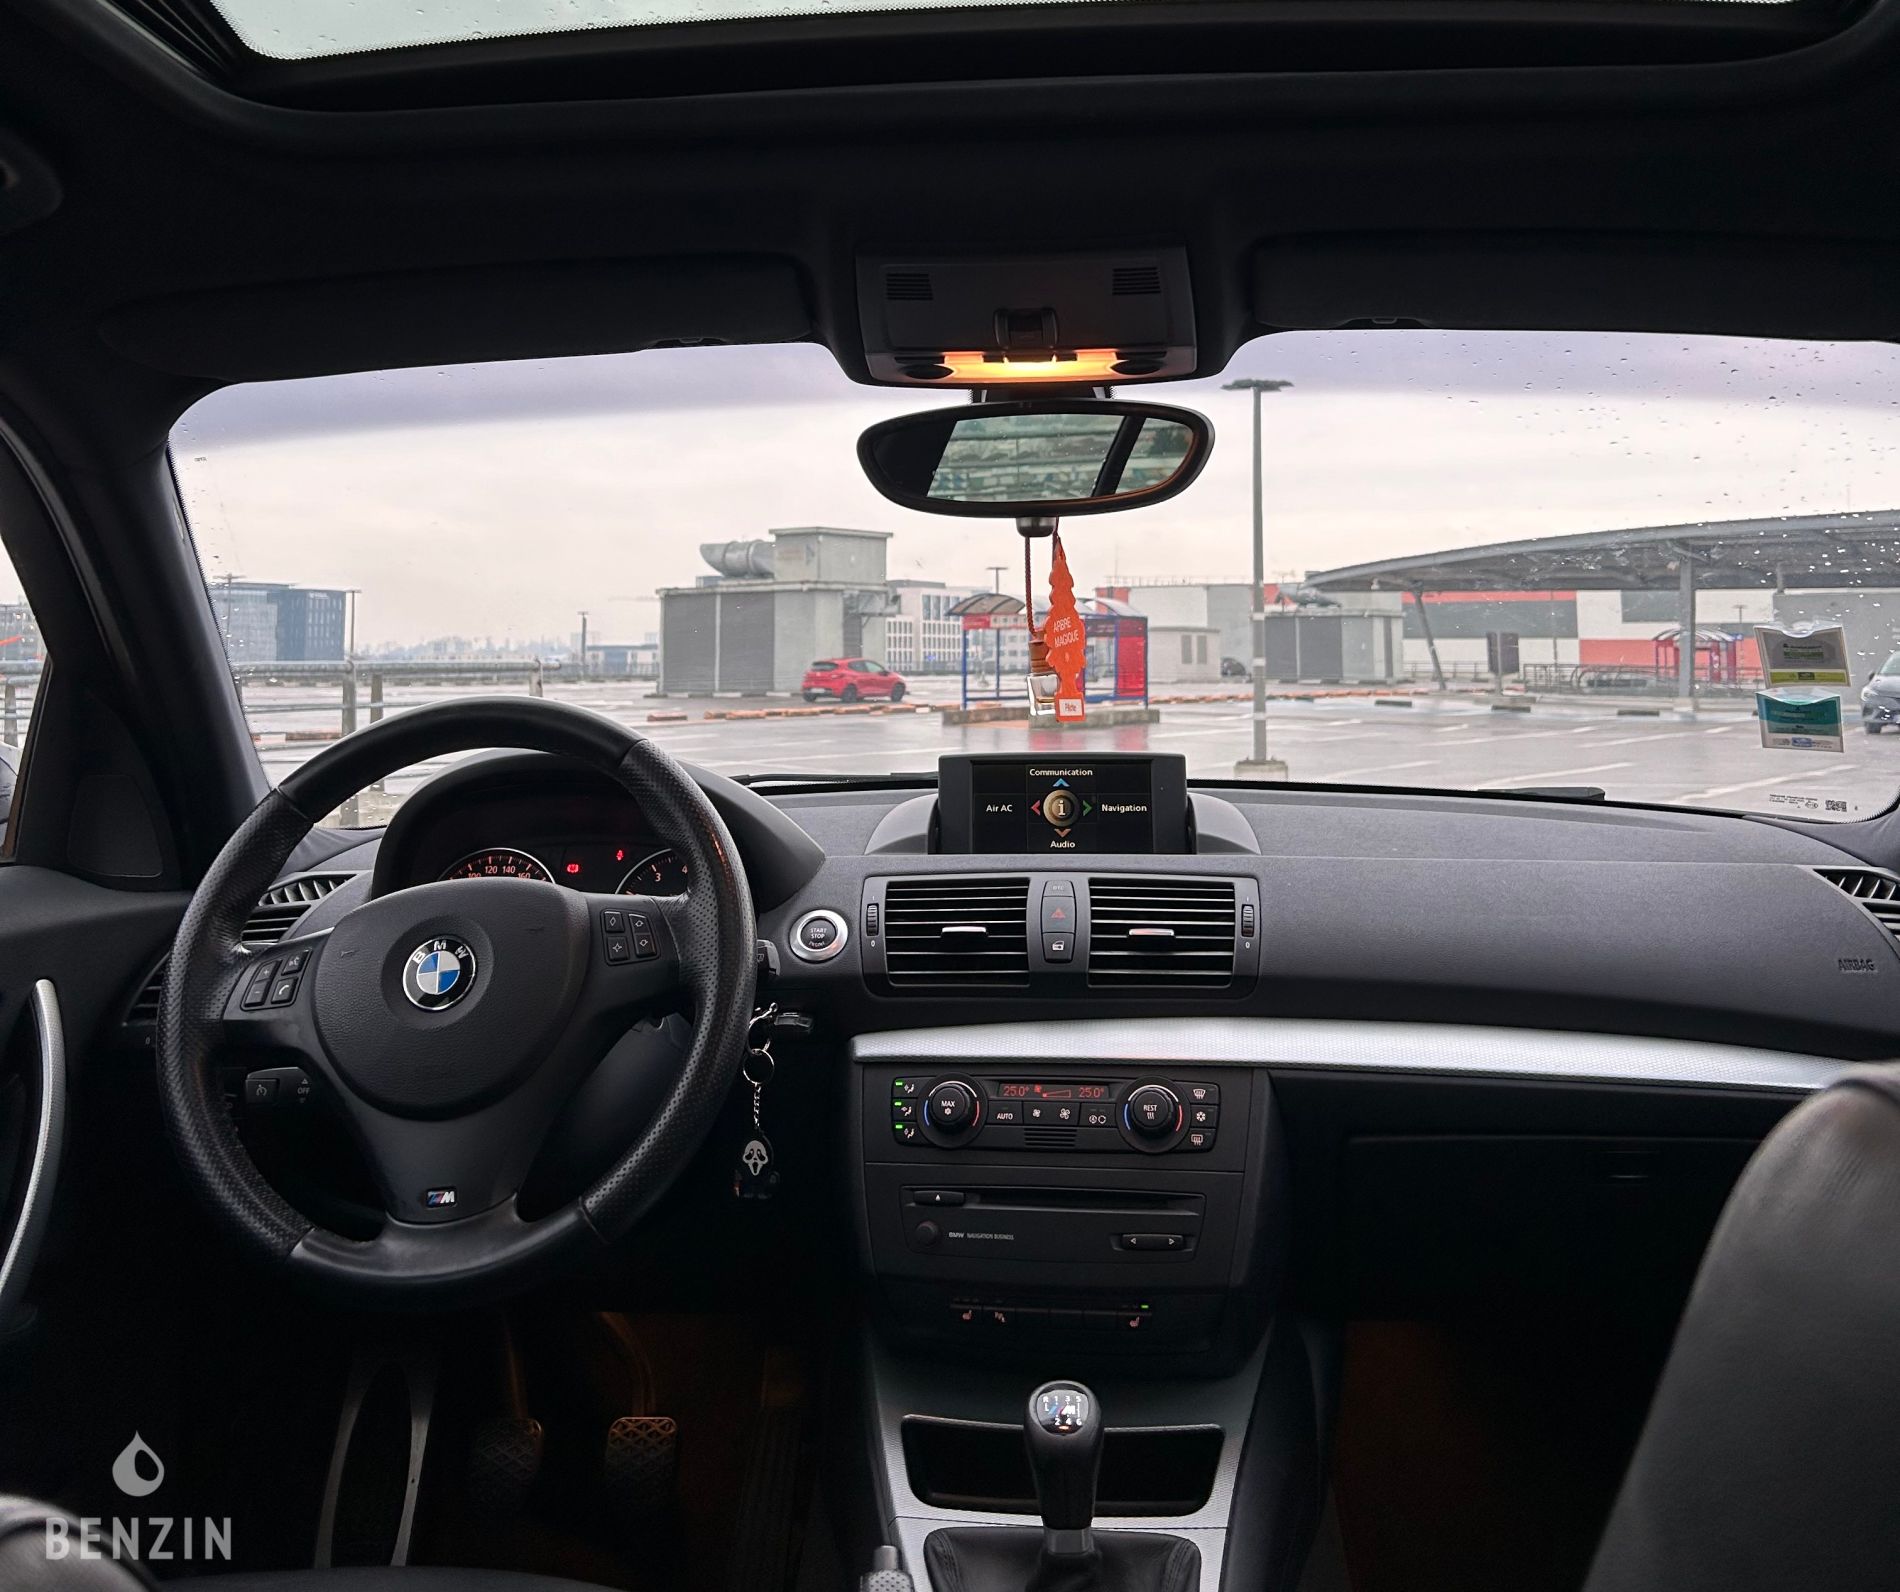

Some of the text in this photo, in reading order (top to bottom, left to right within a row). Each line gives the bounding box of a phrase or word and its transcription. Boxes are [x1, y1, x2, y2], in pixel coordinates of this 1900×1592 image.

[1029, 768, 1093, 776] Communication
[986, 804, 1013, 812] Air AC
[1101, 804, 1148, 813] Navigation
[1050, 840, 1076, 848] Audio
[485, 865, 498, 874] 120
[502, 865, 516, 874] 140
[681, 864, 688, 874] 4
[655, 872, 661, 882] 3
[412, 940, 469, 964] BMW
[297, 1086, 310, 1095] OFF
[1143, 1104, 1157, 1112] REST
[996, 1112, 1013, 1120] AUTO
[1054, 1418, 1082, 1426] 2 4 6
